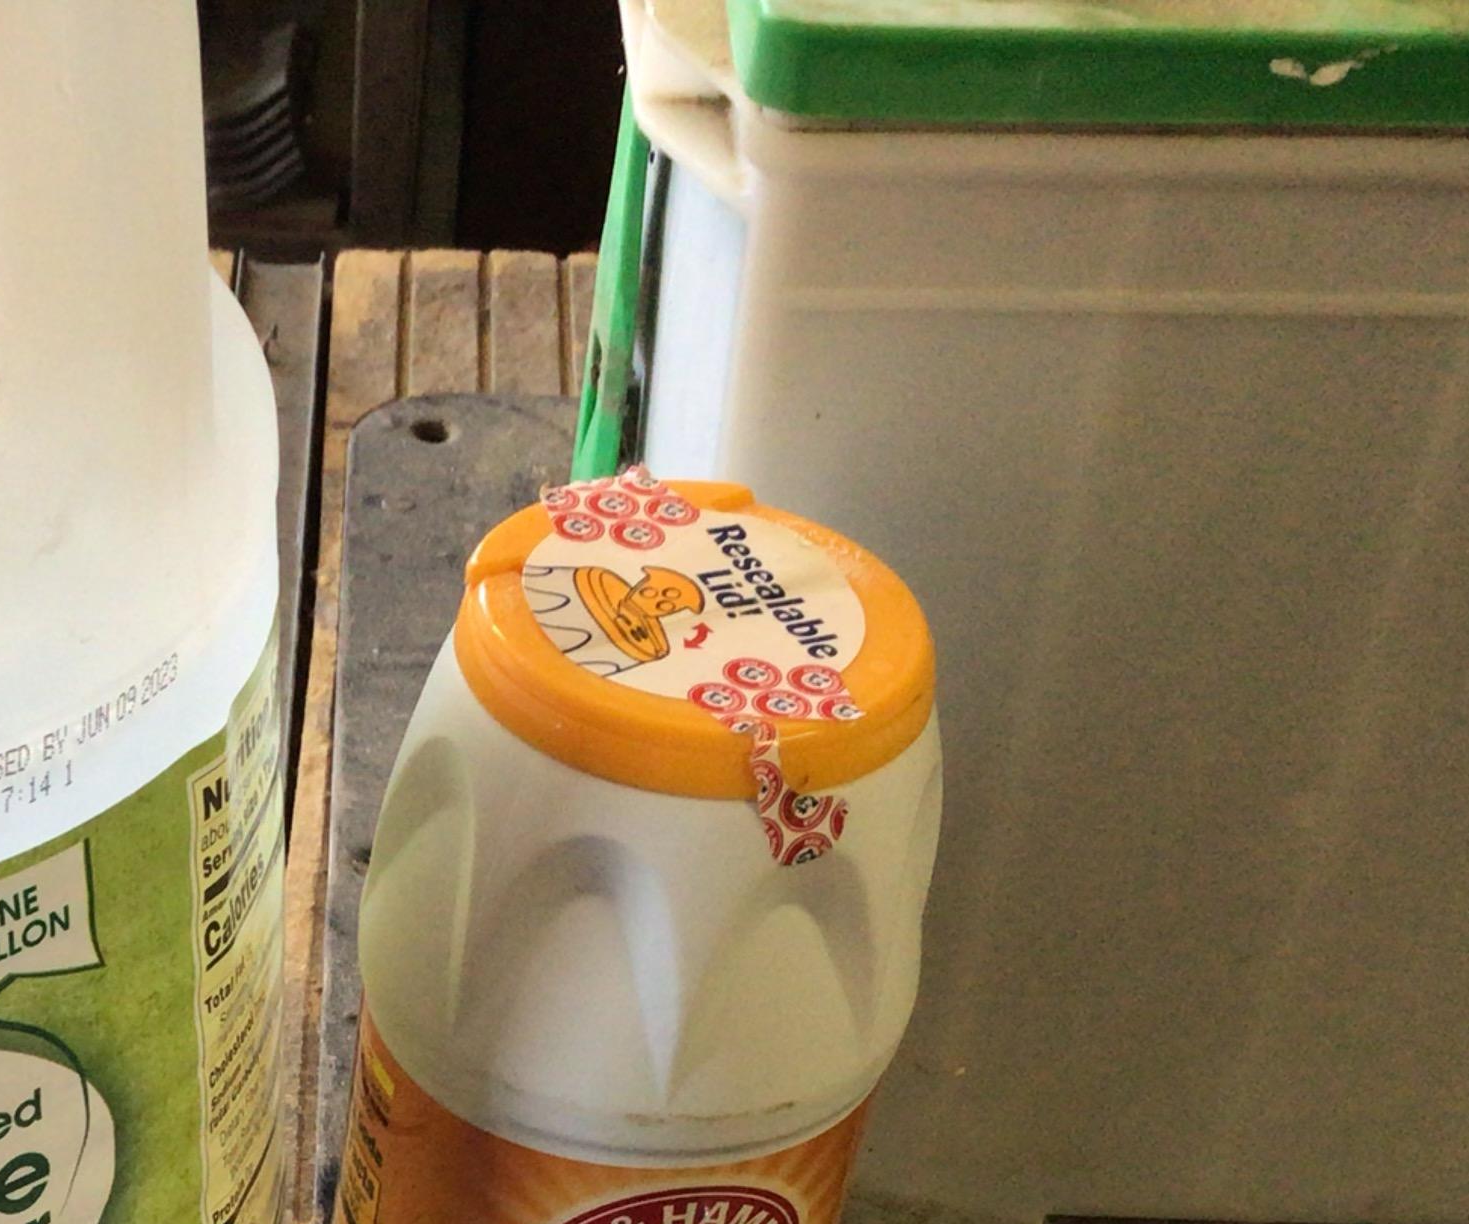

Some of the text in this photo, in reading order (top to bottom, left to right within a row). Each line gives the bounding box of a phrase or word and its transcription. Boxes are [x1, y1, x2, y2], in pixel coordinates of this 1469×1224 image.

[696, 567, 765, 620] Lid!
[706, 523, 839, 661] Resealable
[42, 726, 69, 762] BY
[77, 701, 111, 746] JUN
[115, 685, 137, 723] 09
[204, 976, 234, 1014] Total
